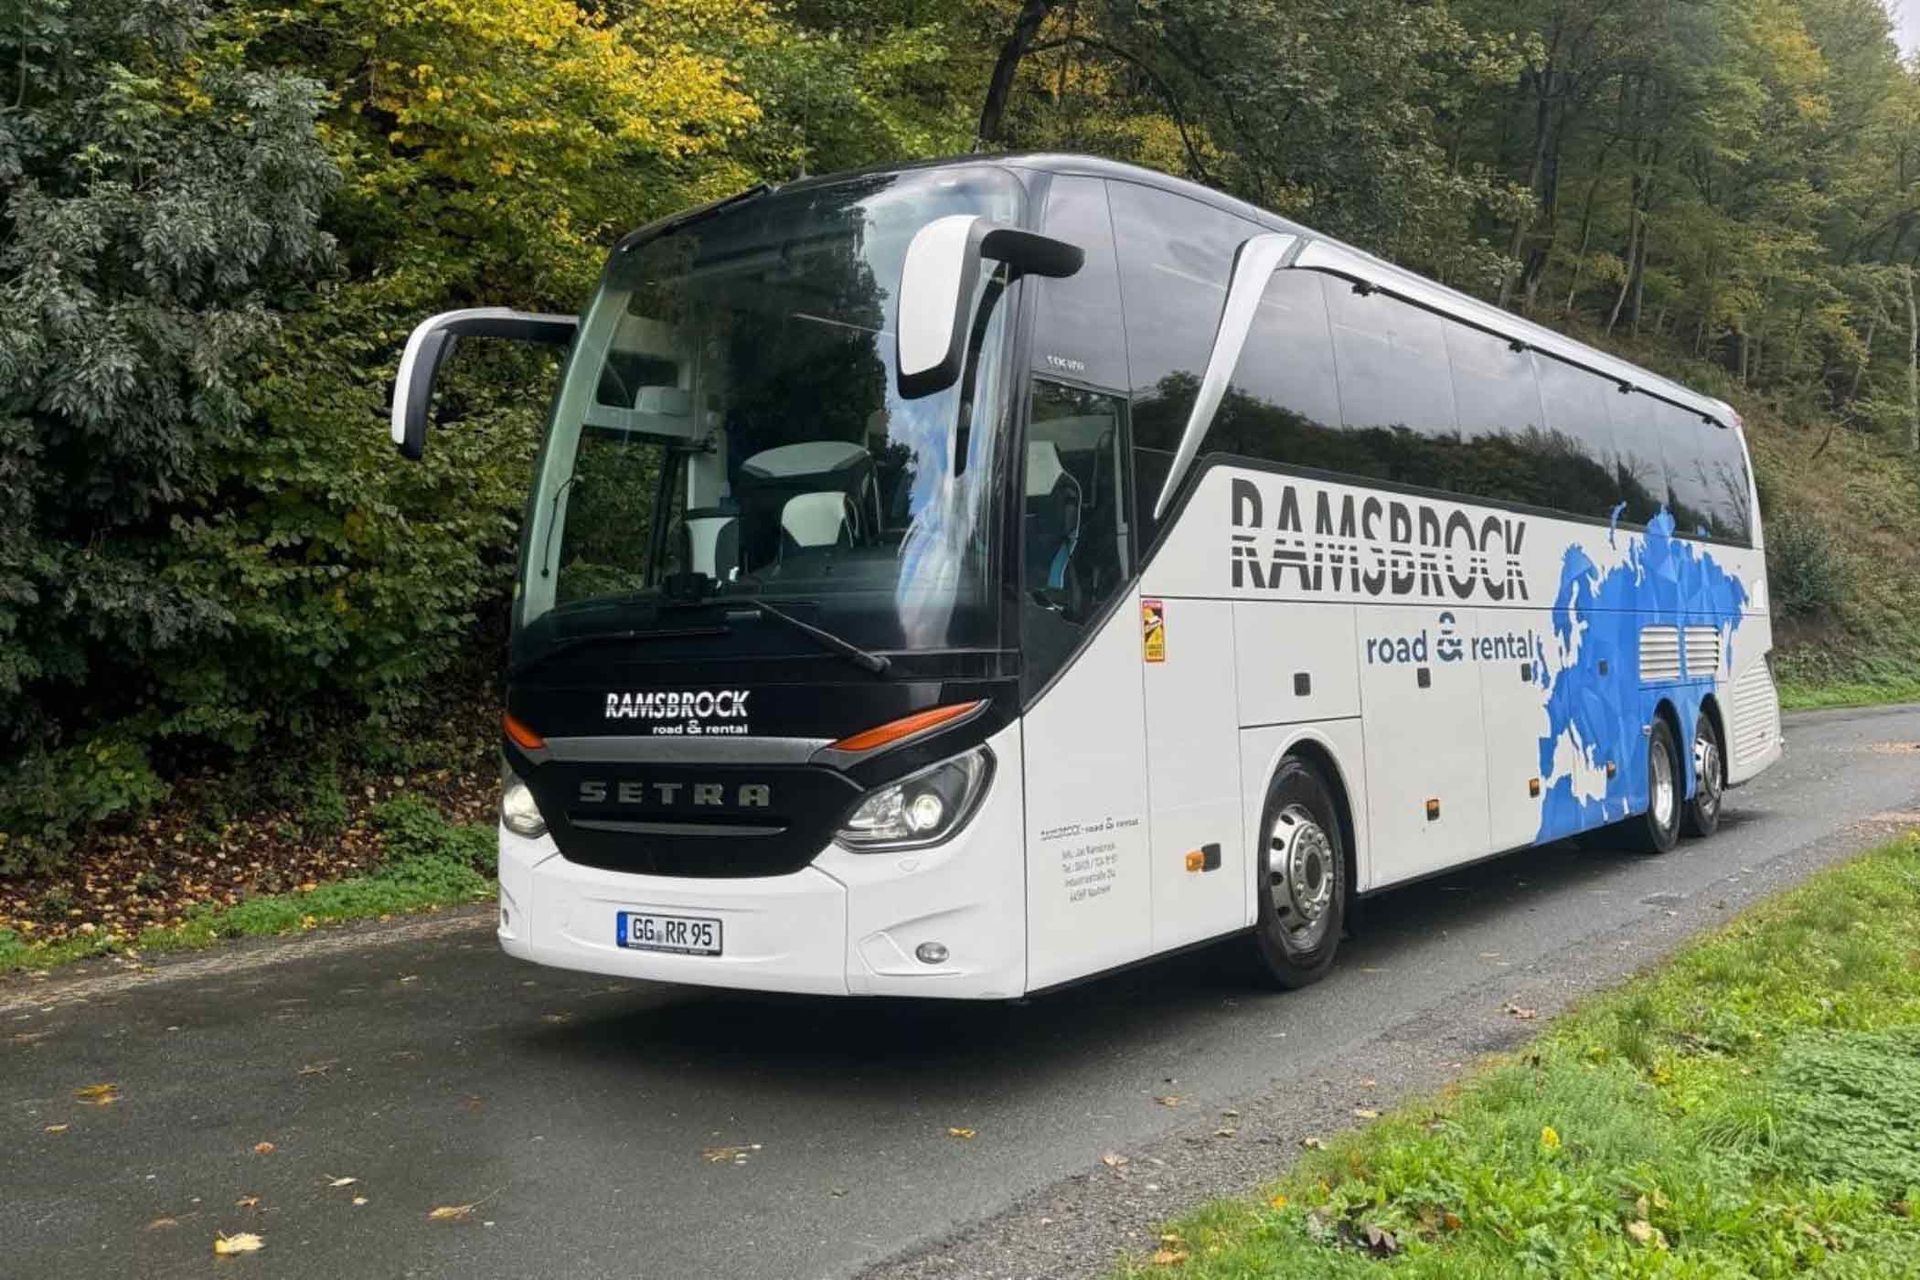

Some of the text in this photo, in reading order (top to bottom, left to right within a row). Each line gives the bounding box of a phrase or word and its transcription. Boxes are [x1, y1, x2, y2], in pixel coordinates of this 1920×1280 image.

[1231, 478, 1529, 600] RAMSBROCK
[1367, 611, 1533, 664] road & rental
[605, 690, 750, 719] RAMSBROCK
[652, 719, 749, 735] road & rental
[579, 780, 770, 808] SETRA
[633, 918, 713, 946] GG RR 95
